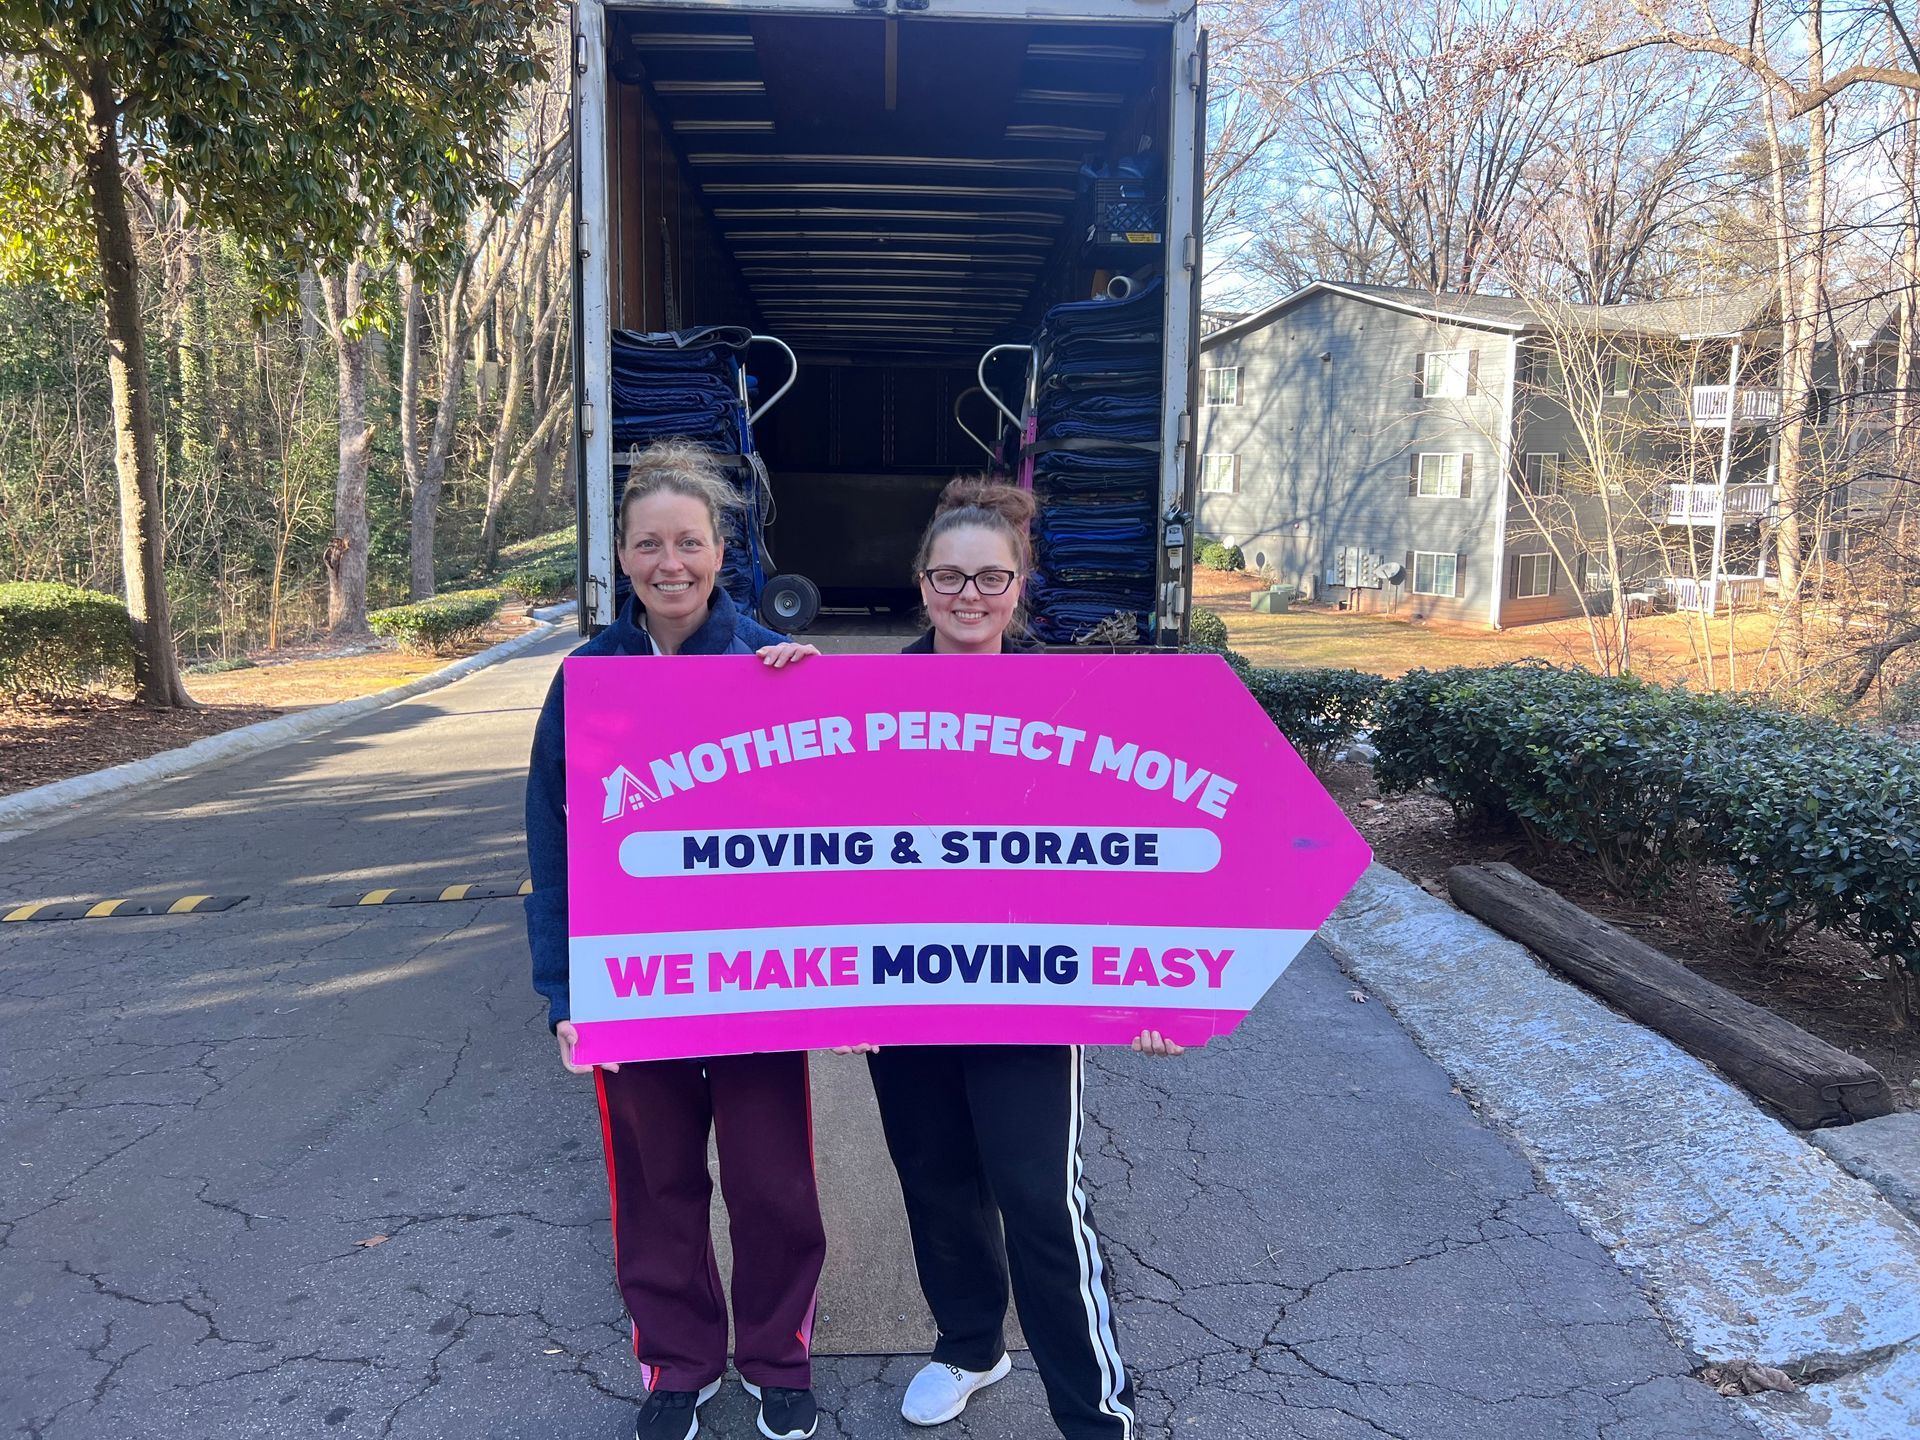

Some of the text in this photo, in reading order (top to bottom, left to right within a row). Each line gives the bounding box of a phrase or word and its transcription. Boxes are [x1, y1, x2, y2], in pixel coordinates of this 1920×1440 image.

[602, 711, 1238, 823] ANOTHER PERFECT MOVE
[683, 831, 1159, 869] MOVING & STORAGE
[605, 943, 1234, 998] WE MAKE MOVING EASY
